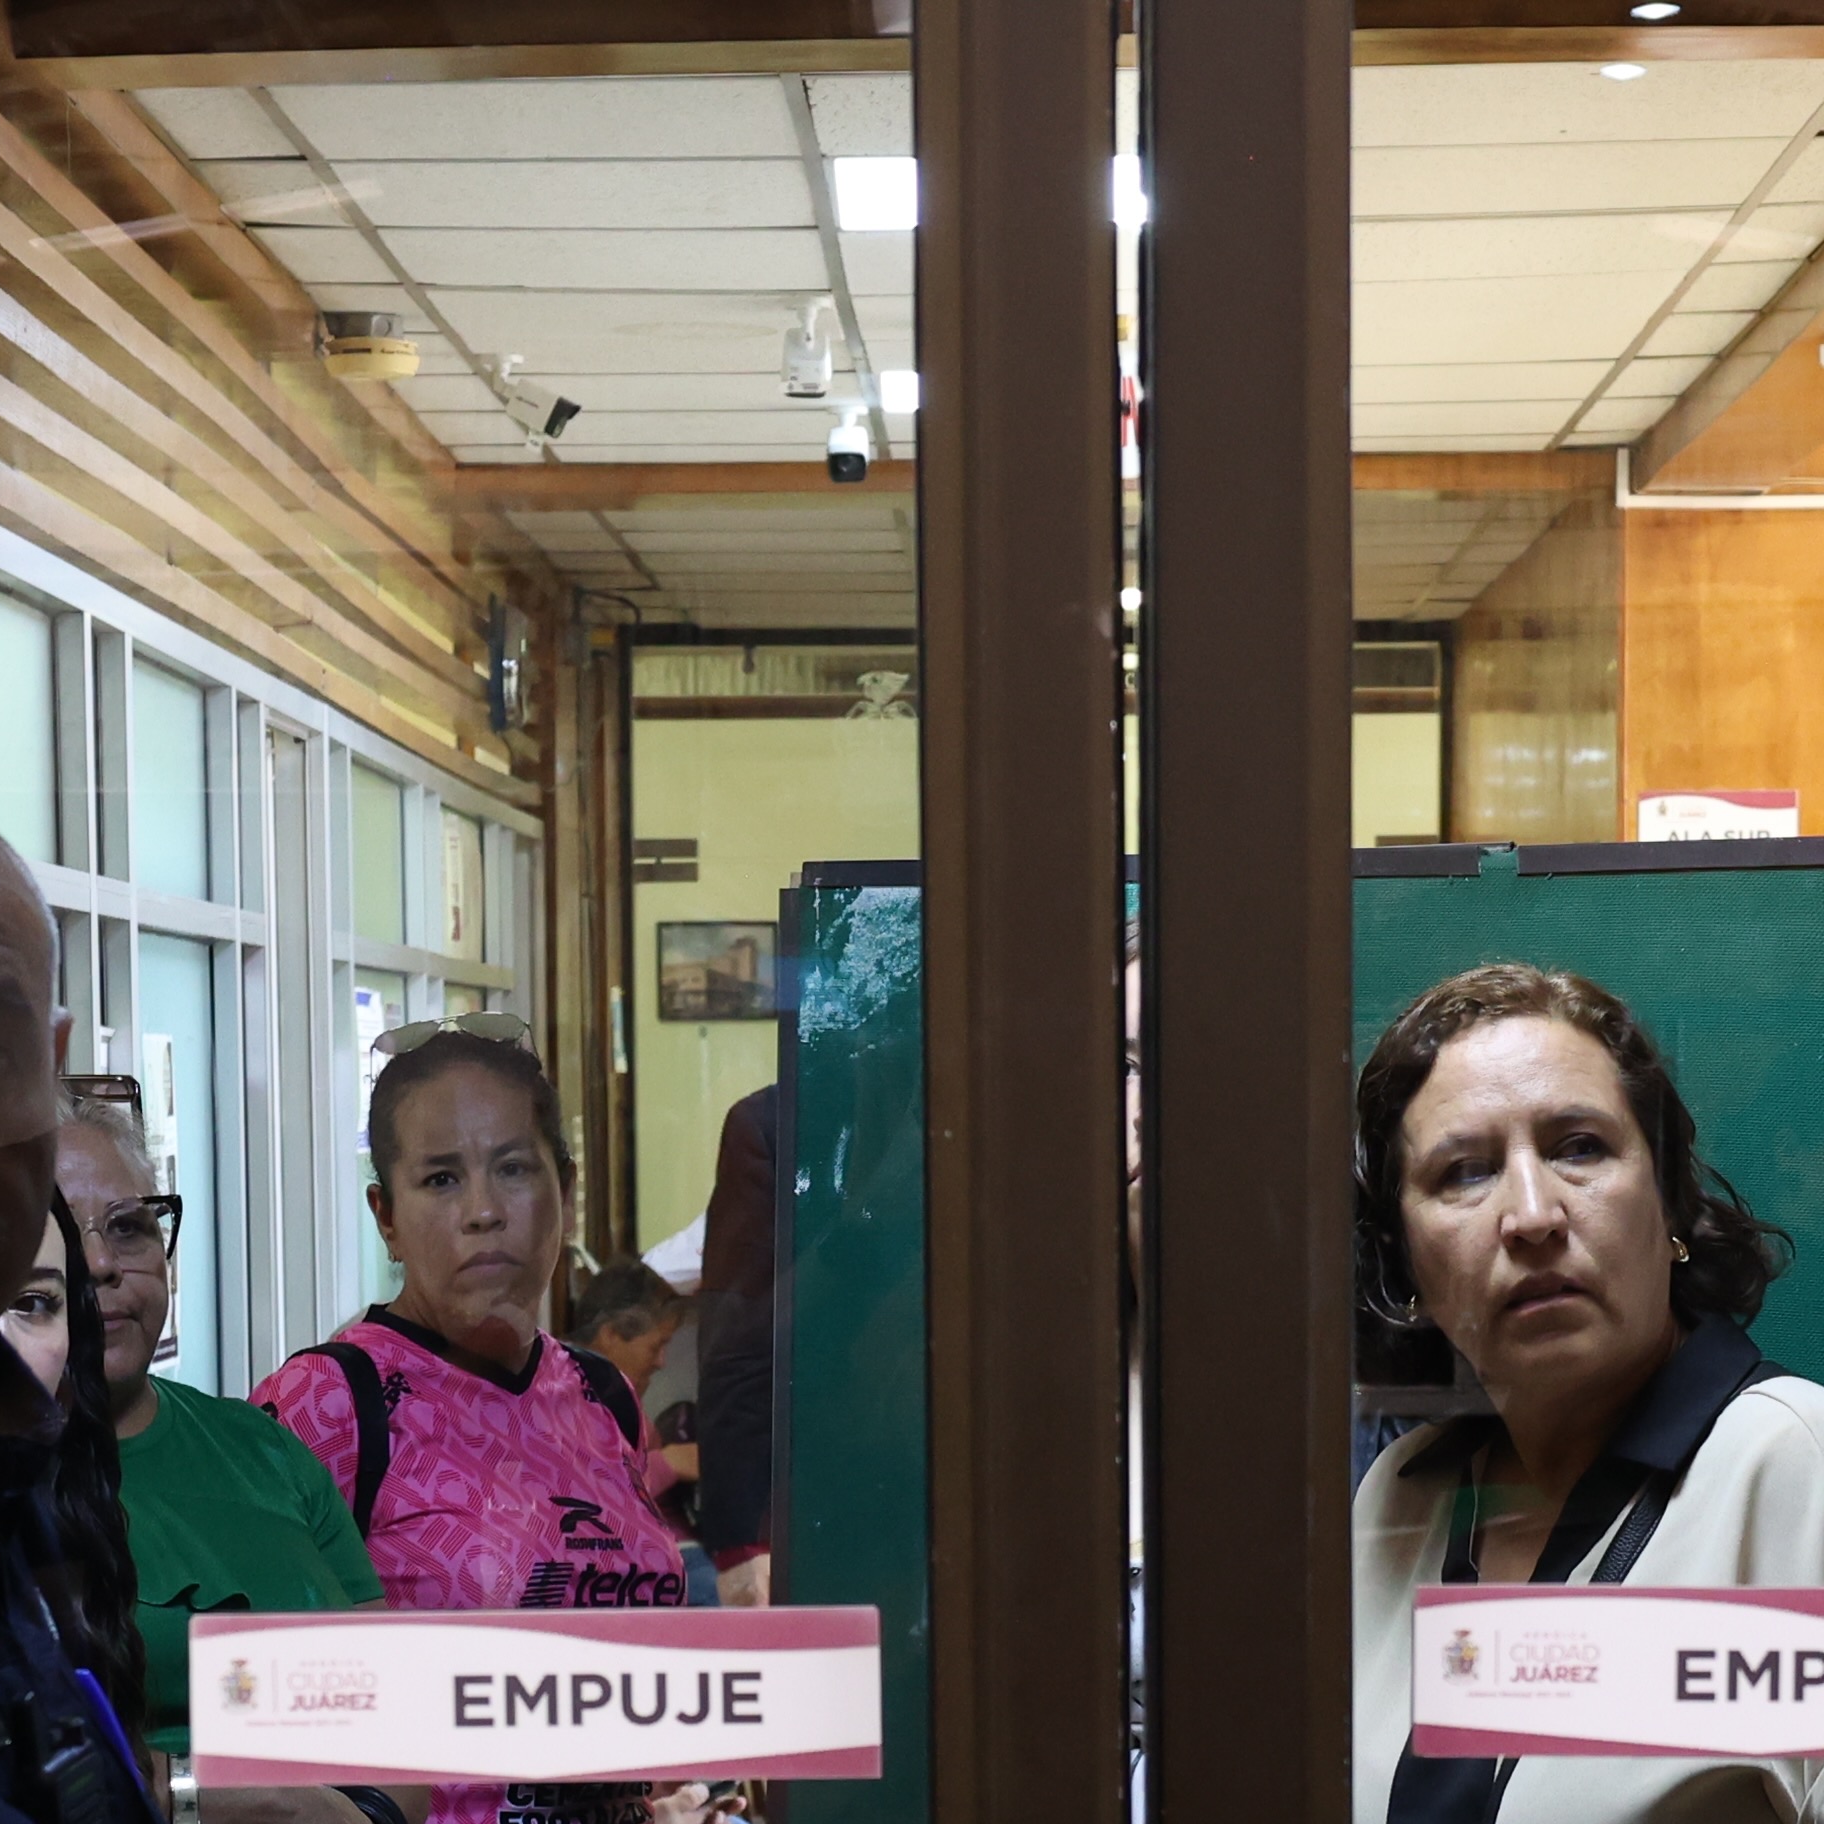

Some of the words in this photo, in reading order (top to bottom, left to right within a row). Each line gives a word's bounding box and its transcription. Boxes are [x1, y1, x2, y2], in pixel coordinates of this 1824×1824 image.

[1509, 1643, 1600, 1663] CIUDAD
[286, 1670, 378, 1691] CIUDAD
[1509, 1663, 1600, 1684] JUÁREZ
[287, 1689, 378, 1713] JUÁREZ
[454, 1672, 763, 1727] EMPUJE
